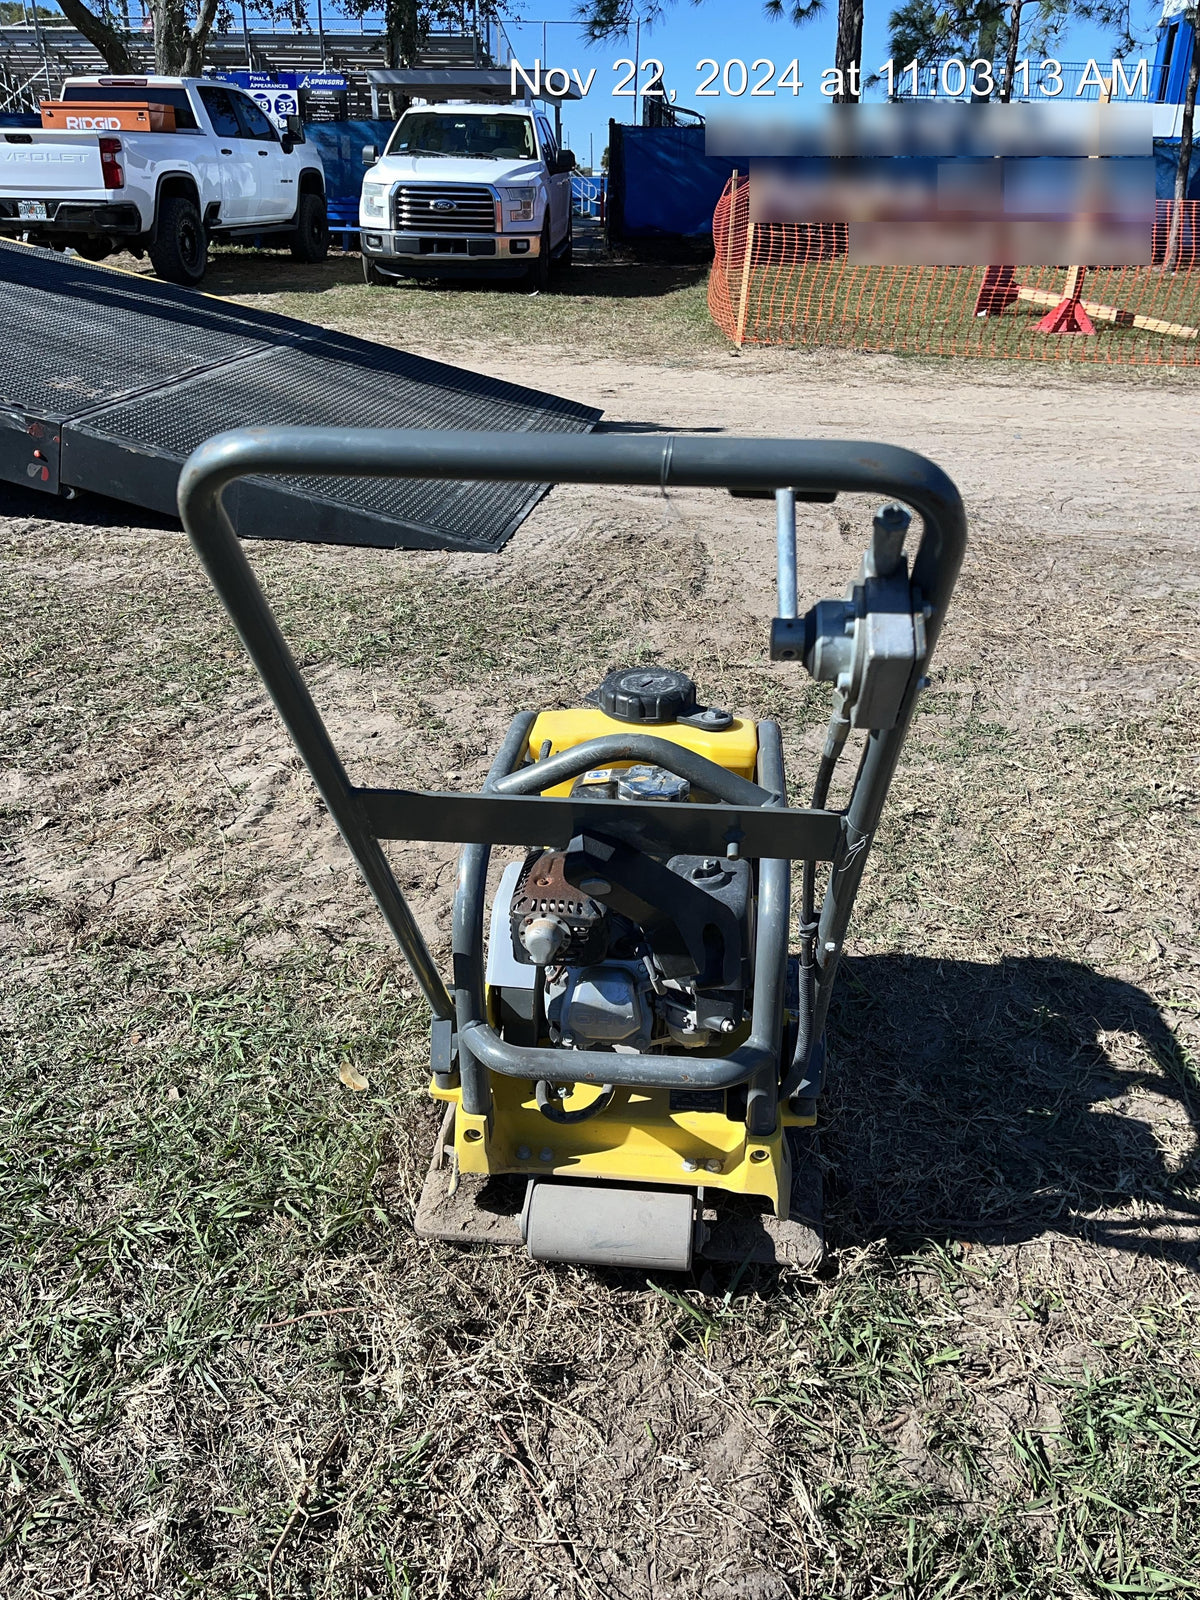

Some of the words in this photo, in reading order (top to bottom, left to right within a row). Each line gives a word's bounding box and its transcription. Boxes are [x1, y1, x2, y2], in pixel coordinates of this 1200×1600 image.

[310, 78, 345, 86] SPONSORS
[278, 101, 294, 112] 32
[66, 116, 121, 130] RIDGID
